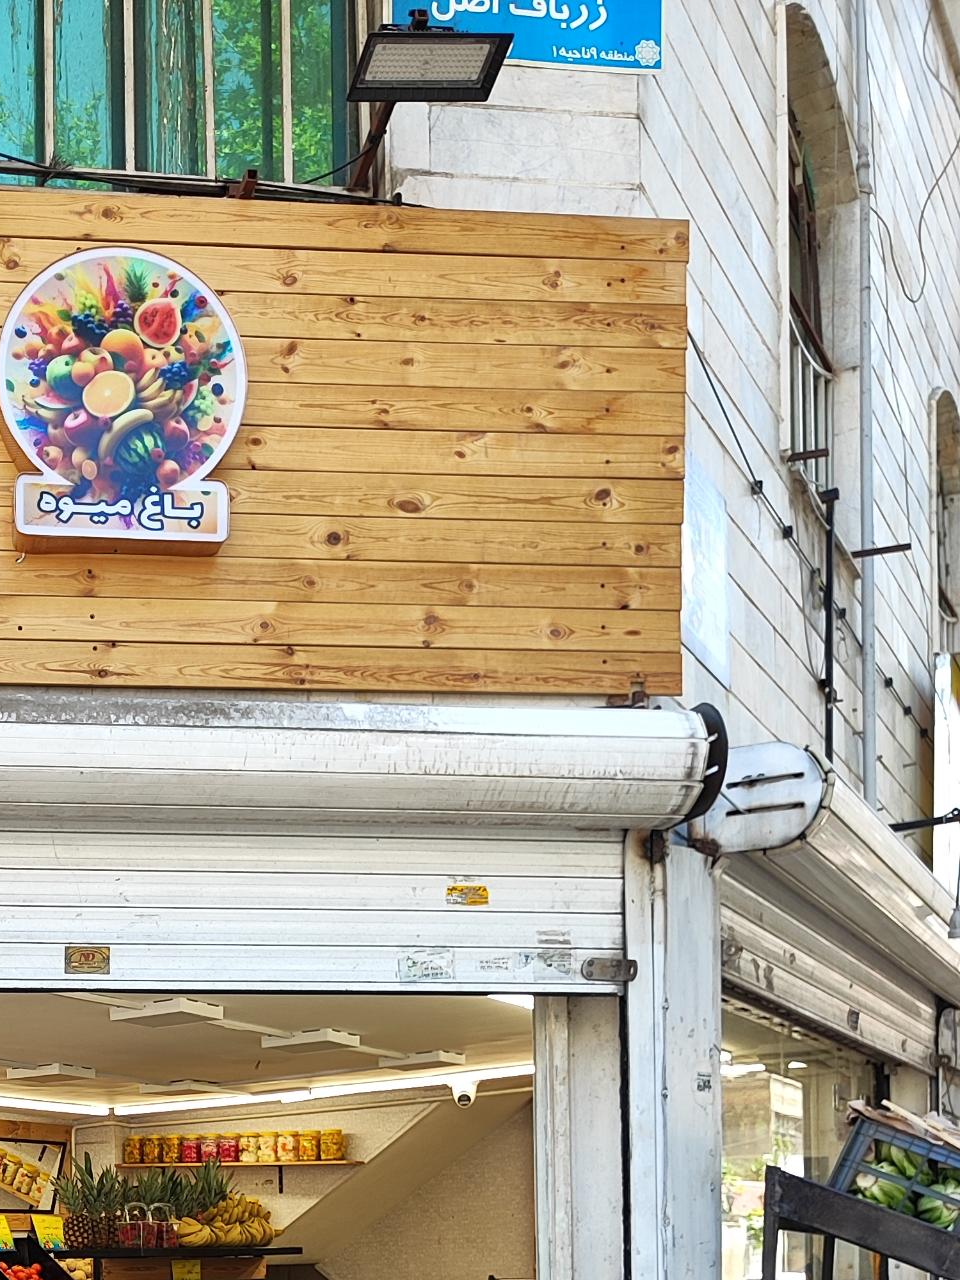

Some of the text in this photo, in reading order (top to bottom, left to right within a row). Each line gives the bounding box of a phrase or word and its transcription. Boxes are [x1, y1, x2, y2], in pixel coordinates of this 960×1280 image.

[558, 46, 590, 61] ناحیه
[599, 49, 635, 62] منطقه
[37, 485, 204, 531] باغ میوه
